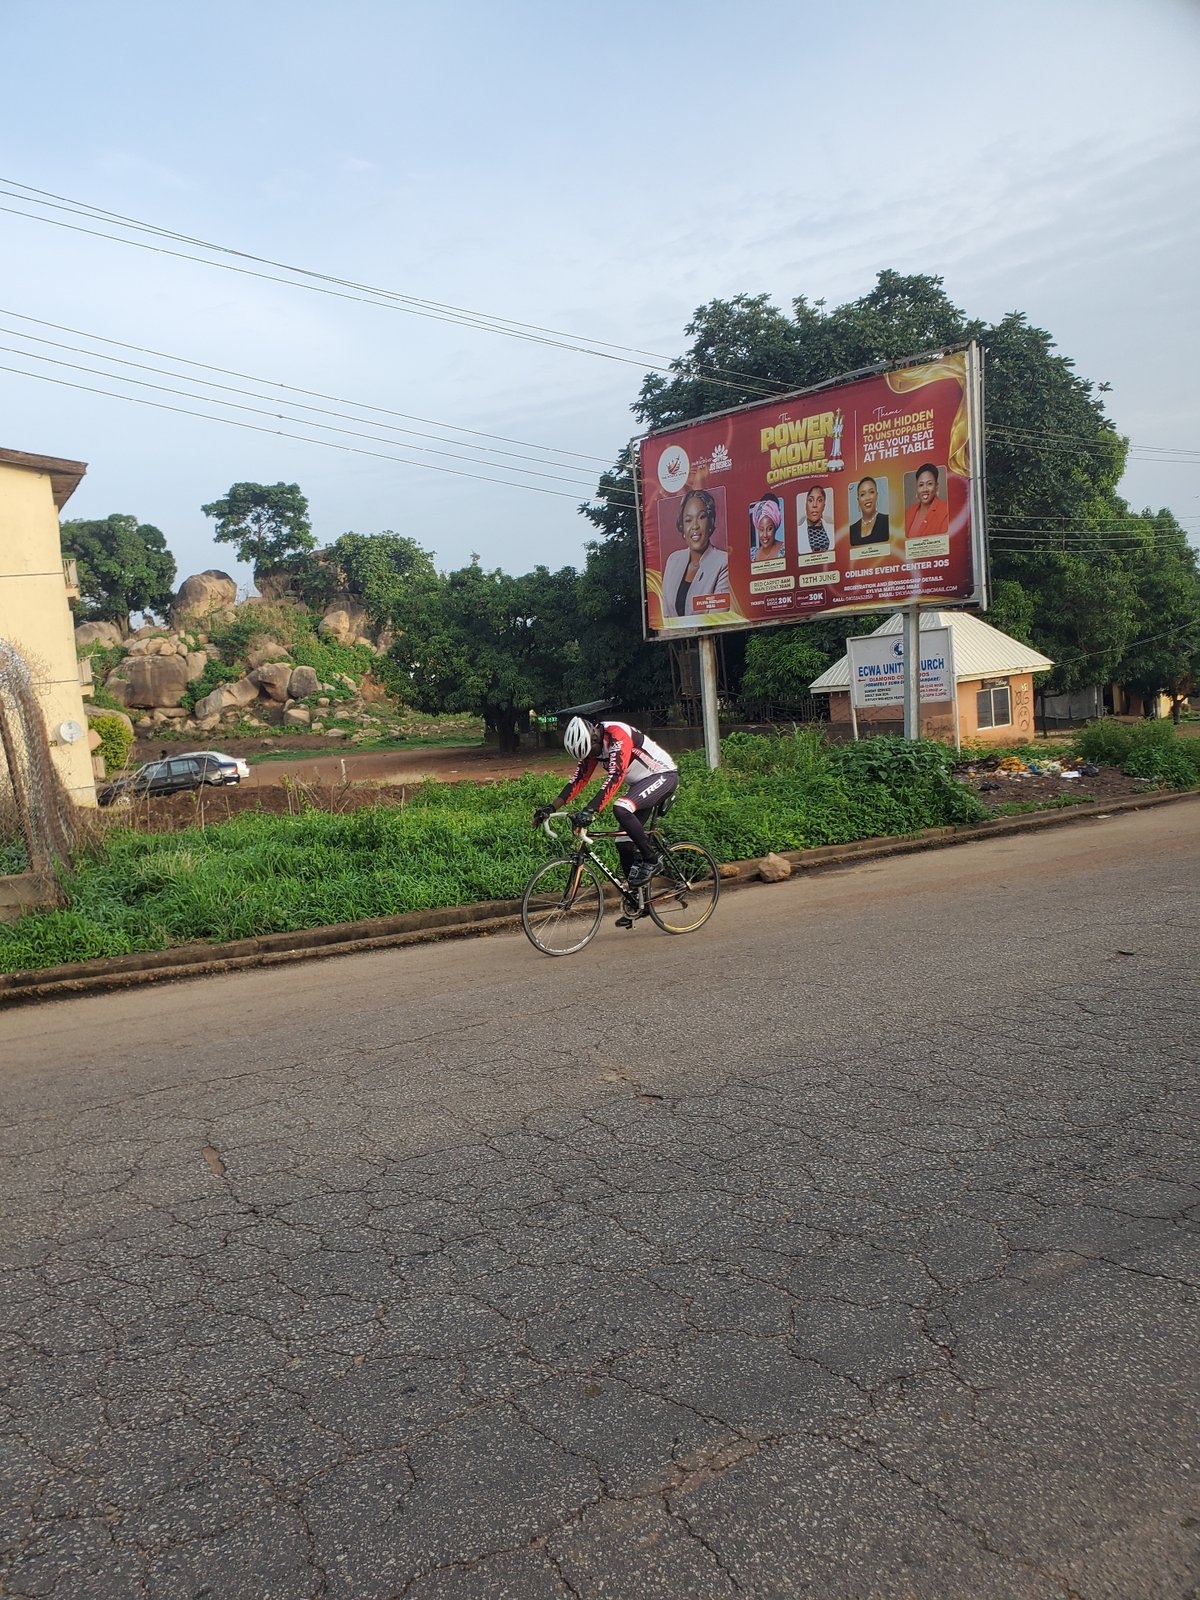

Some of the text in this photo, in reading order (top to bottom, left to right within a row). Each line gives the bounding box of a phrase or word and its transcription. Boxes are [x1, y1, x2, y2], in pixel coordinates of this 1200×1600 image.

[778, 412, 792, 424] The
[863, 409, 933, 434] FROM HIDDEN
[760, 412, 834, 452] POWER
[876, 421, 934, 440] UNSTOPPABLE:
[863, 430, 934, 452] TAKE YOUR SEAT
[864, 439, 935, 463] AT THE TABLE
[770, 438, 825, 470] MOVE
[767, 459, 828, 484] CONFERENCE
[819, 573, 836, 582] JUNE
[845, 559, 949, 578] ODILINS EVENT CENTER JOS
[778, 596, 792, 604] 20K
[808, 592, 824, 600] 30K
[858, 665, 881, 677] ECWA
[920, 658, 944, 670] URCH
[639, 775, 667, 798] TREK
